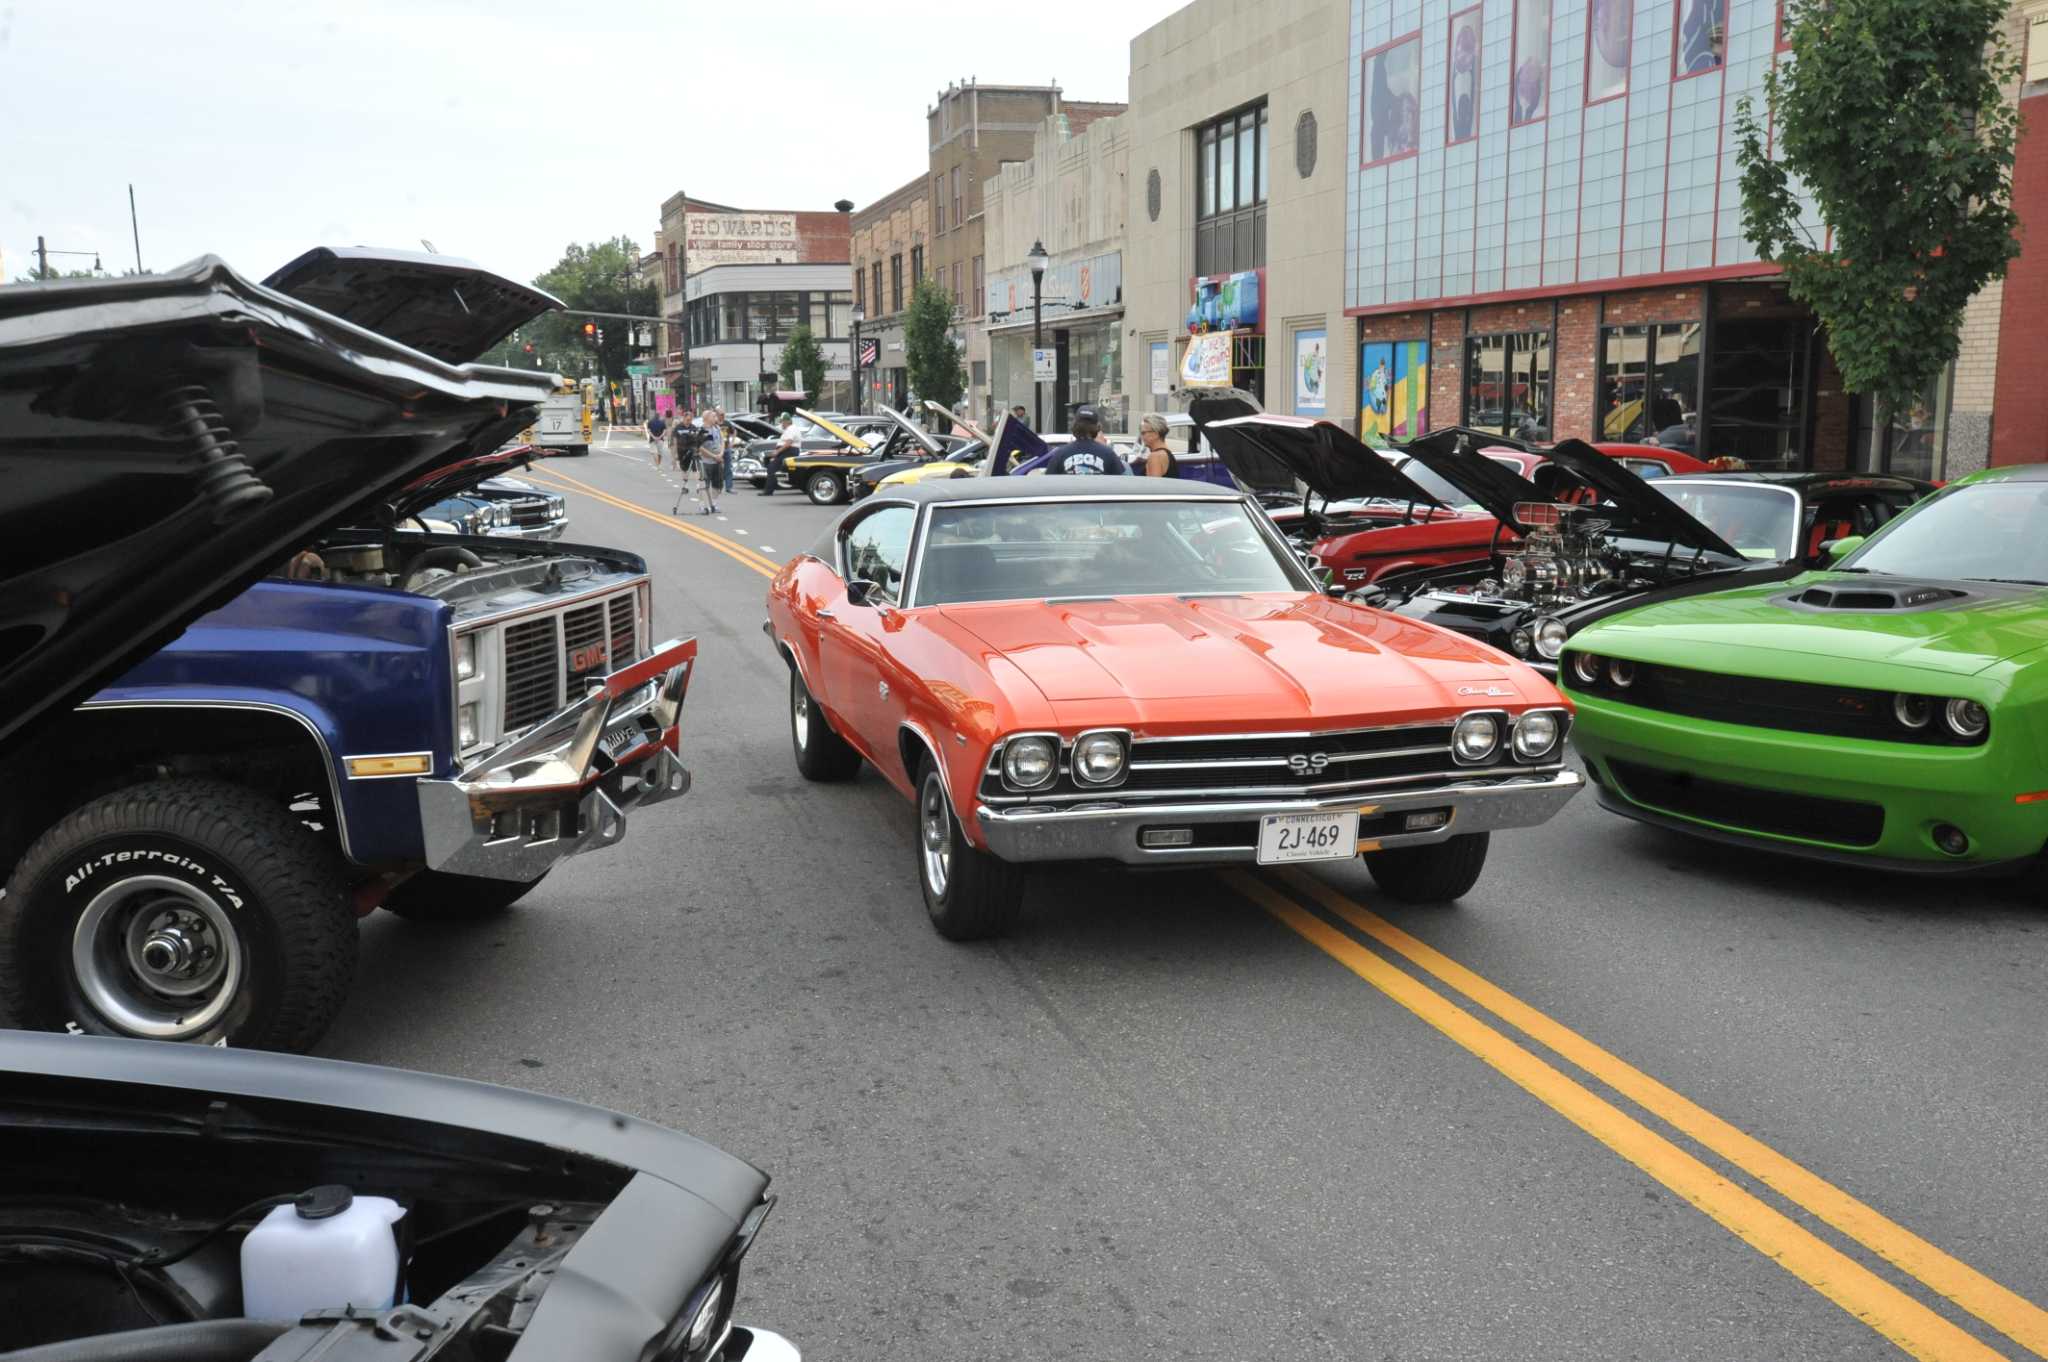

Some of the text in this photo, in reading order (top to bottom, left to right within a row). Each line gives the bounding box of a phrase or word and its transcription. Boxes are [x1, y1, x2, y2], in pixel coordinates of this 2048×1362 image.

[690, 218, 793, 236] HOWARD'S
[573, 640, 608, 671] GMC
[1289, 753, 1328, 769] SS
[65, 850, 244, 909] All-Terrain T/A
